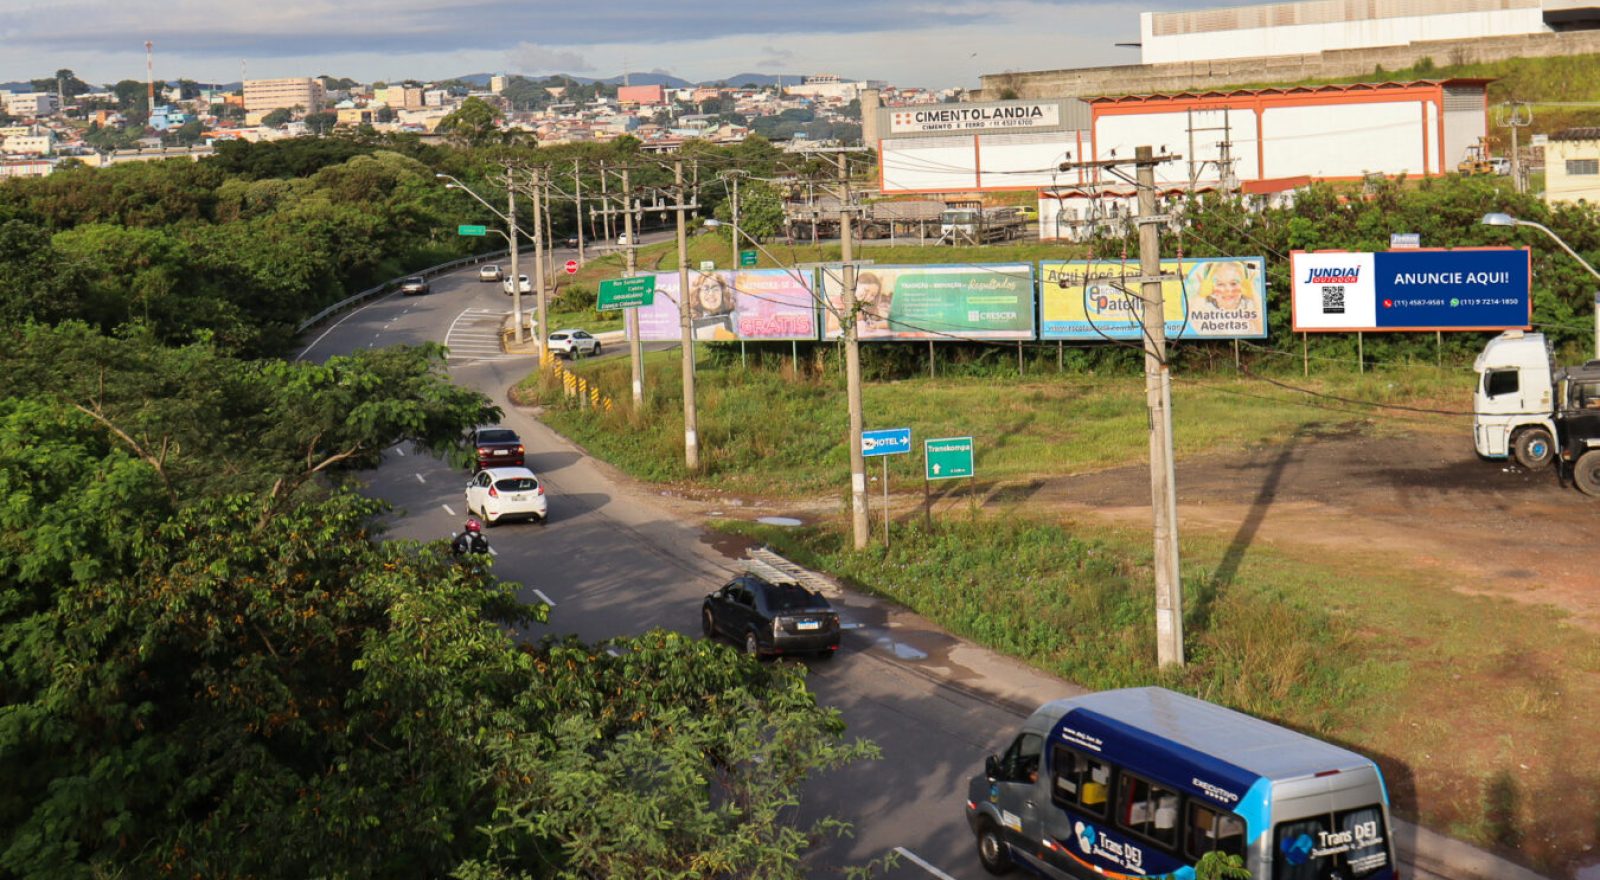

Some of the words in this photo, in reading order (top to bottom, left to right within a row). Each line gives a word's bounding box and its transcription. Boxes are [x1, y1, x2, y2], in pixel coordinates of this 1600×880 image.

[915, 106, 1043, 123] CIMENTOLANDIA
[1394, 273, 1462, 285] ANUNCIE
[1465, 271, 1509, 286] AQUI!
[1460, 299, 1475, 307] (11)
[1201, 321, 1248, 330] Abertas
[875, 437, 899, 448] HOTEL
[1192, 777, 1238, 802] EXECUTIVO
[1318, 830, 1352, 848] Trans
[1354, 821, 1376, 840] DEJ
[1099, 831, 1123, 856] Trans
[1124, 843, 1142, 868] DEJ
